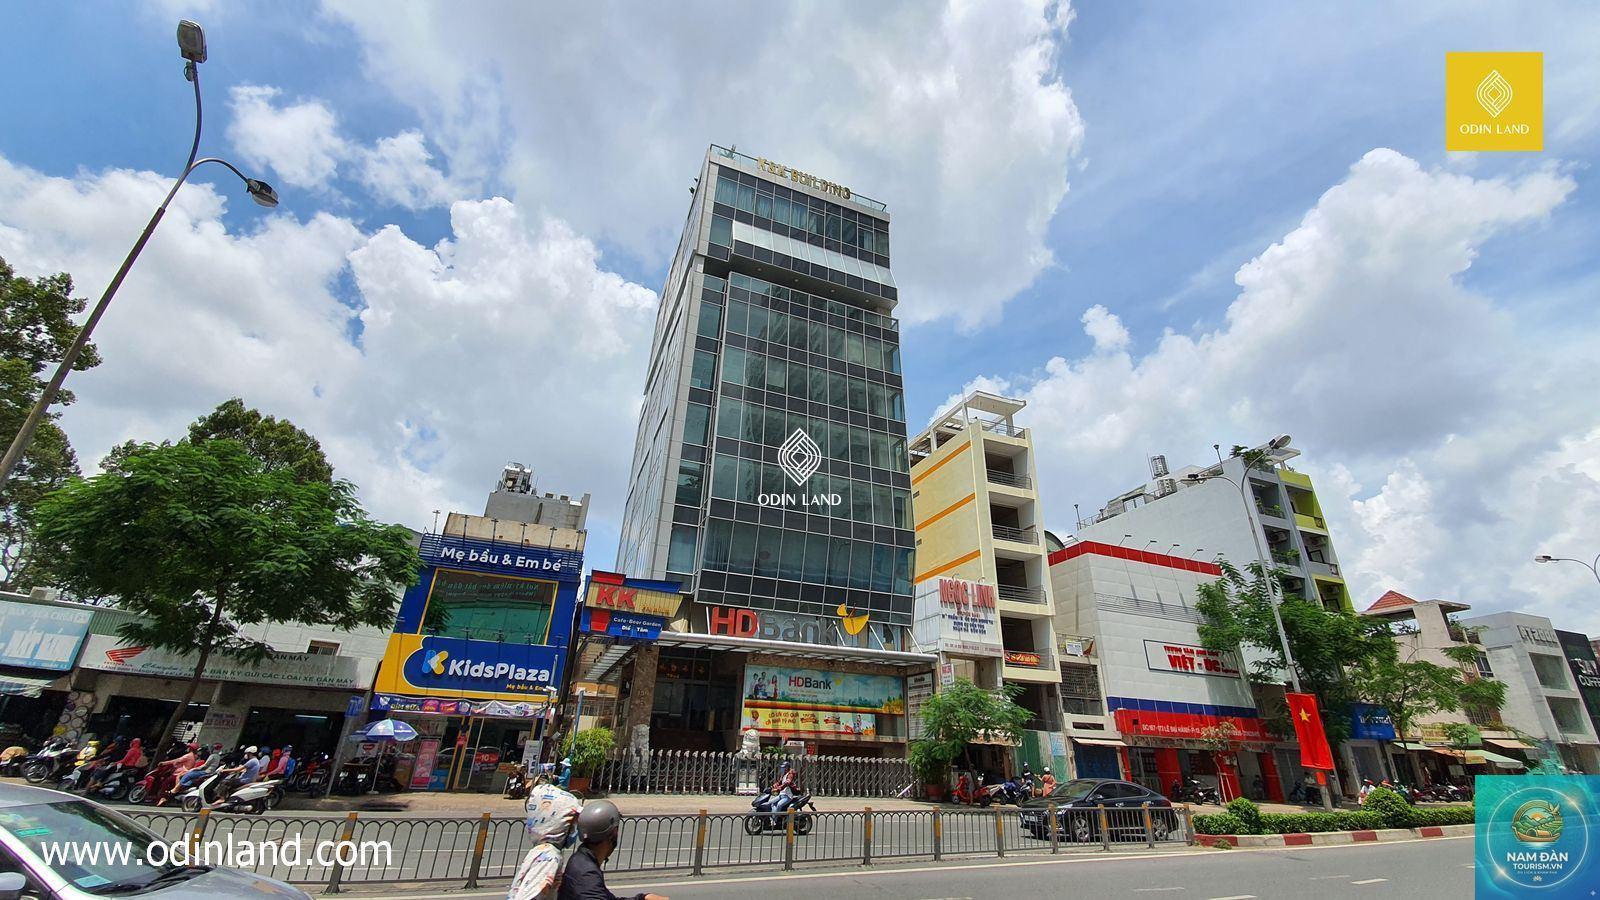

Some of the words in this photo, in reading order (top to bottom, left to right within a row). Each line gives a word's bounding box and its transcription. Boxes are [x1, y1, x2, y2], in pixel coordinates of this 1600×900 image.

[791, 169, 850, 200] BUILDING
[441, 547, 465, 562] Mẹ
[469, 549, 498, 564] bầu
[502, 554, 512, 565] &
[516, 556, 539, 569] Em
[542, 558, 561, 571] bé
[939, 579, 969, 610] NGỌC
[970, 583, 996, 608] LINH
[448, 659, 550, 682] KidsPlaza
[789, 675, 832, 690] HDBank
